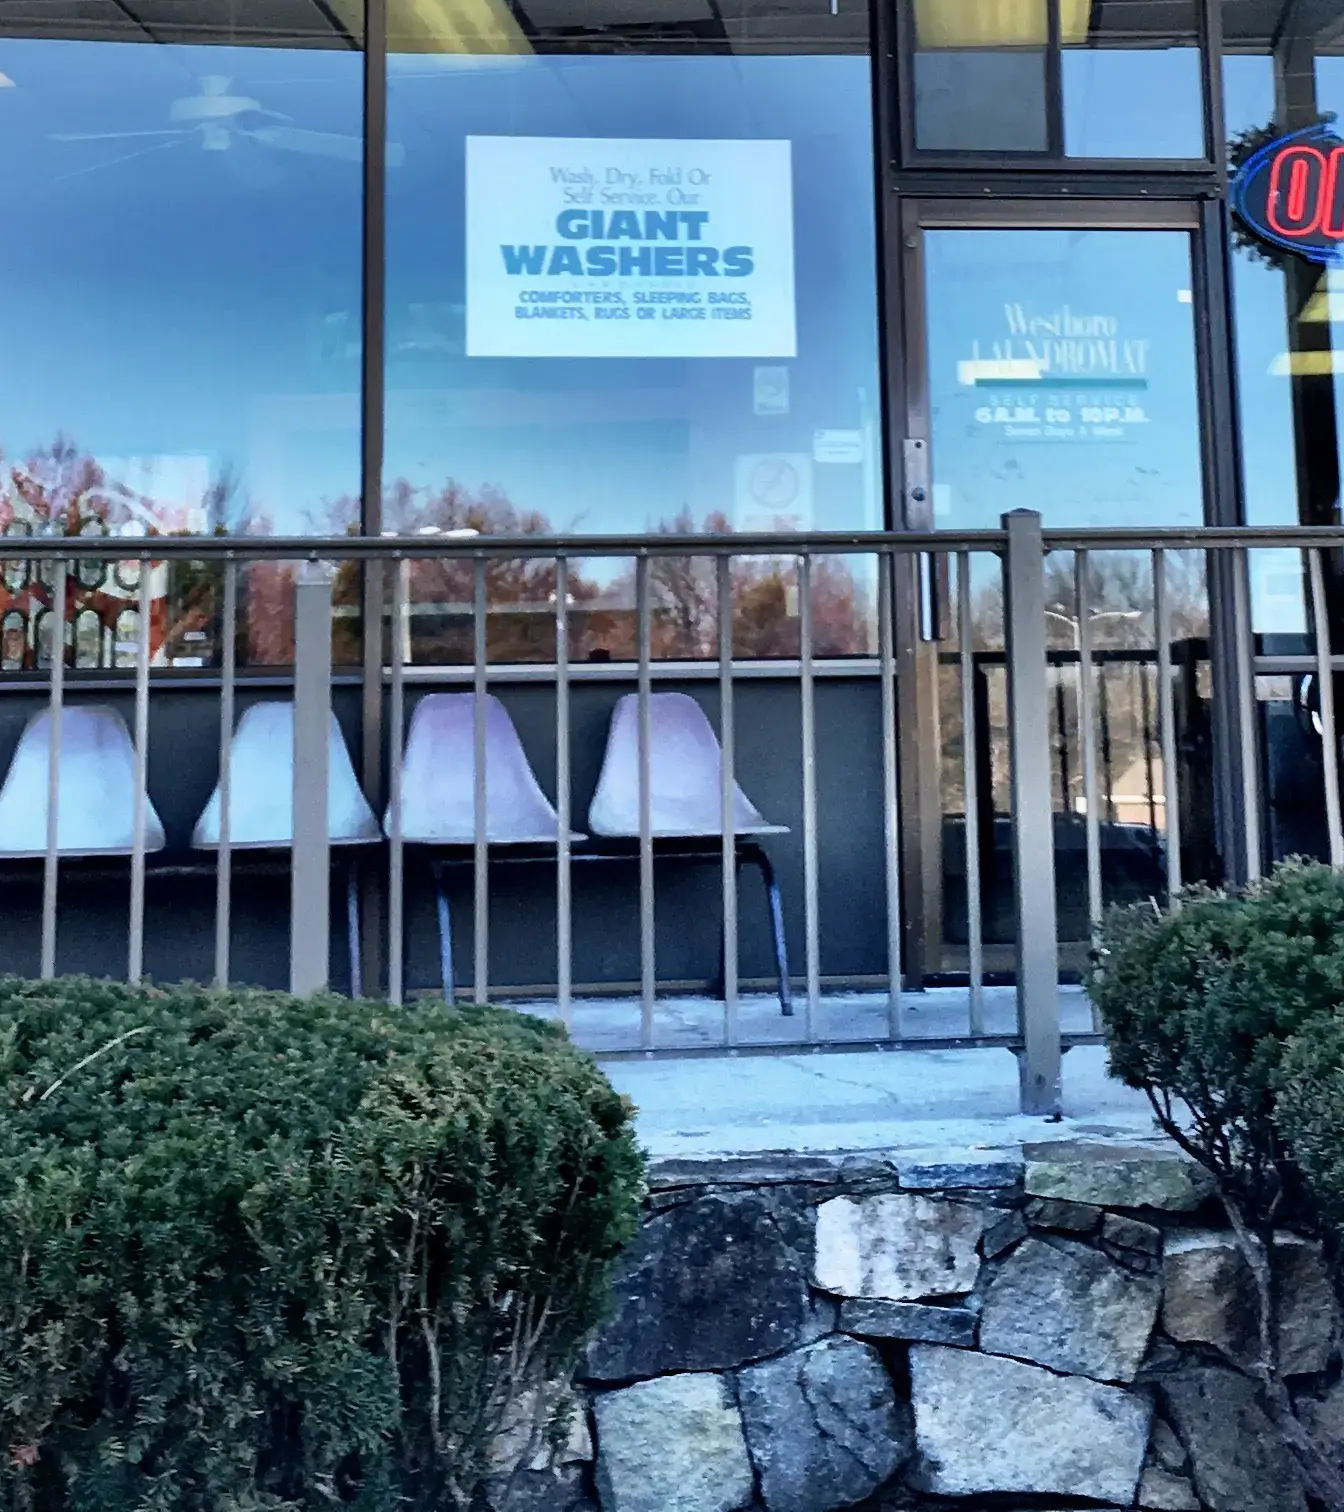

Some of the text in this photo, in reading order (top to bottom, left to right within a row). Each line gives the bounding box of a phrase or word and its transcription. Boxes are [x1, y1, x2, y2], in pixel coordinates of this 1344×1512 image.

[649, 166, 682, 186] Fold
[687, 168, 713, 186] Or
[556, 208, 710, 240] GIANT
[500, 244, 755, 278] WASHERS
[519, 290, 627, 306] COMFORTERS,
[632, 291, 702, 305] SLEEPING
[594, 306, 631, 320] RUGS
[636, 306, 656, 320] OR
[662, 306, 706, 321] LARGE
[711, 307, 753, 321] ITEMS
